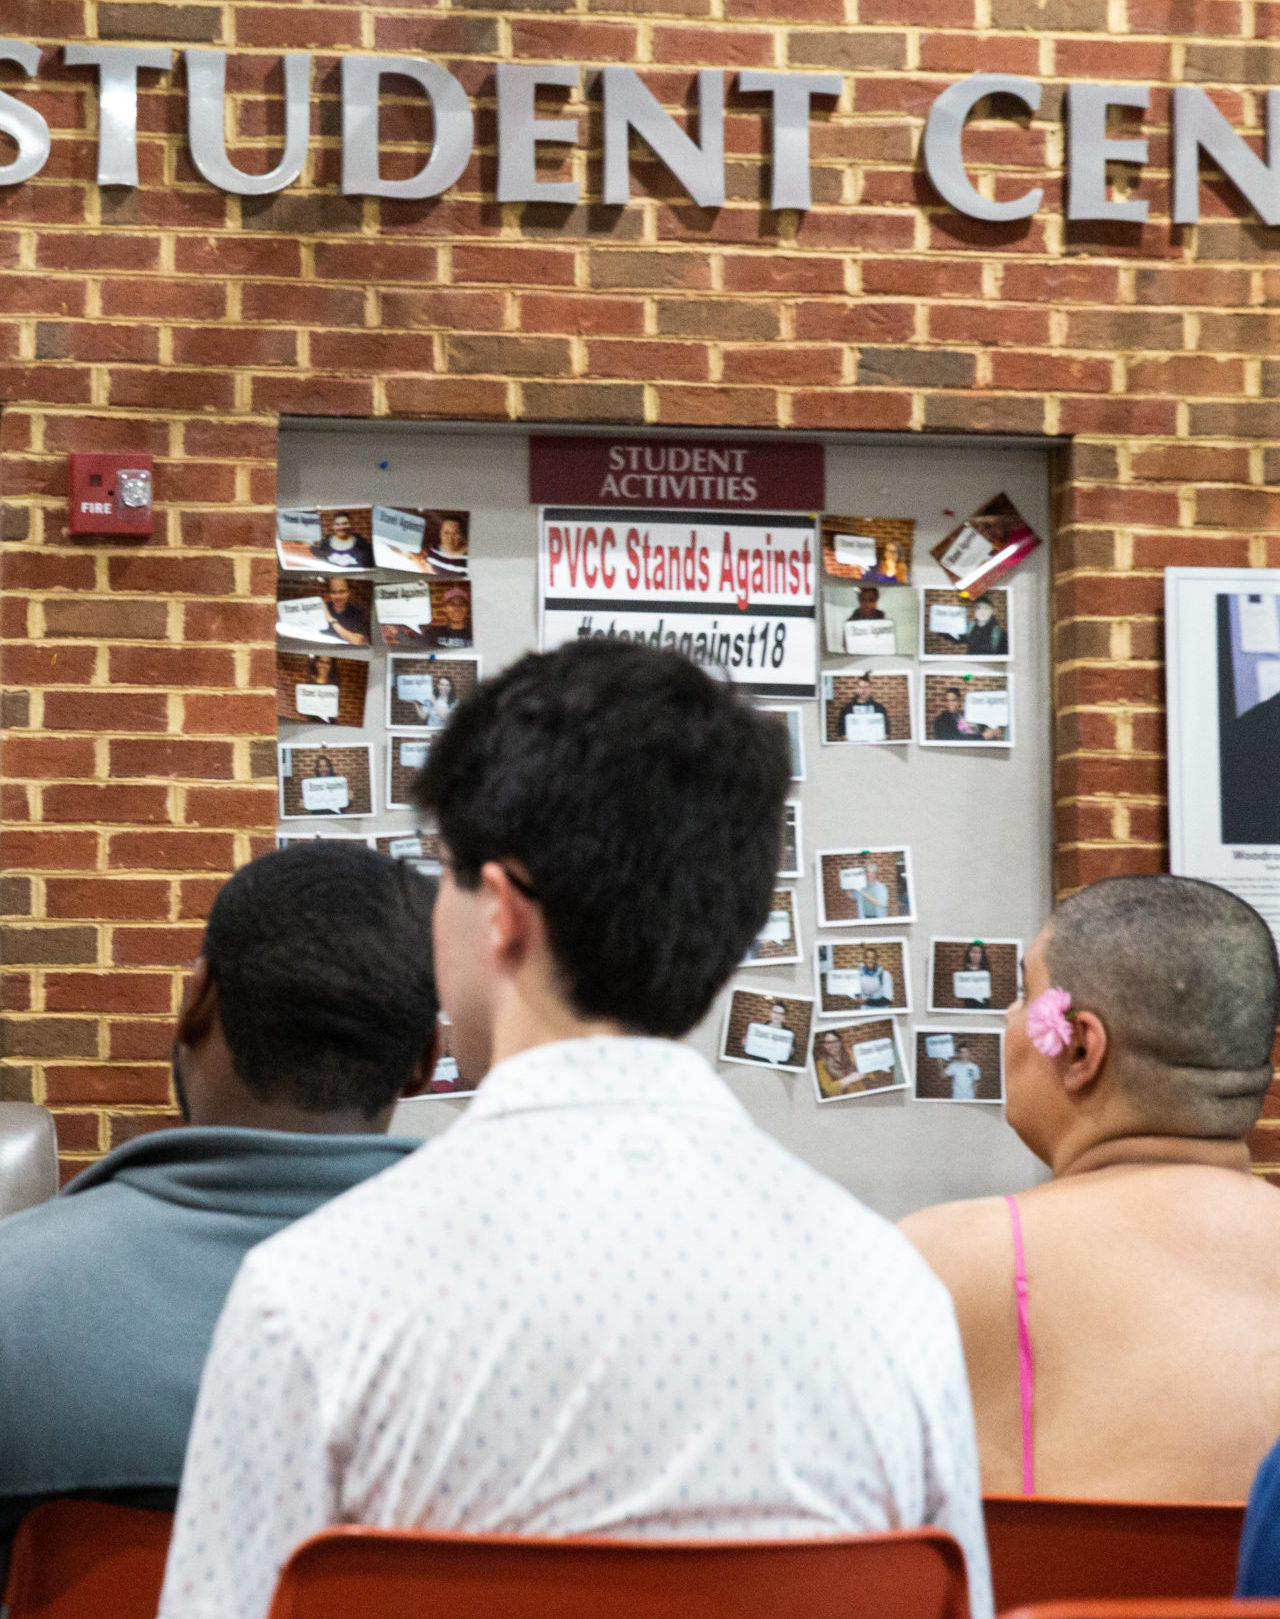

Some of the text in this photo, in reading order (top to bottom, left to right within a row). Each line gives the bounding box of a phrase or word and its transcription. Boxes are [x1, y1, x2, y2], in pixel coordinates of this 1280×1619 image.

[924, 72, 1280, 226] CEN
[609, 446, 749, 474] STUDENT
[600, 474, 758, 501] ACTIVITIES
[81, 502, 112, 514] FIRE
[548, 527, 812, 611] PVCC Stands Against
